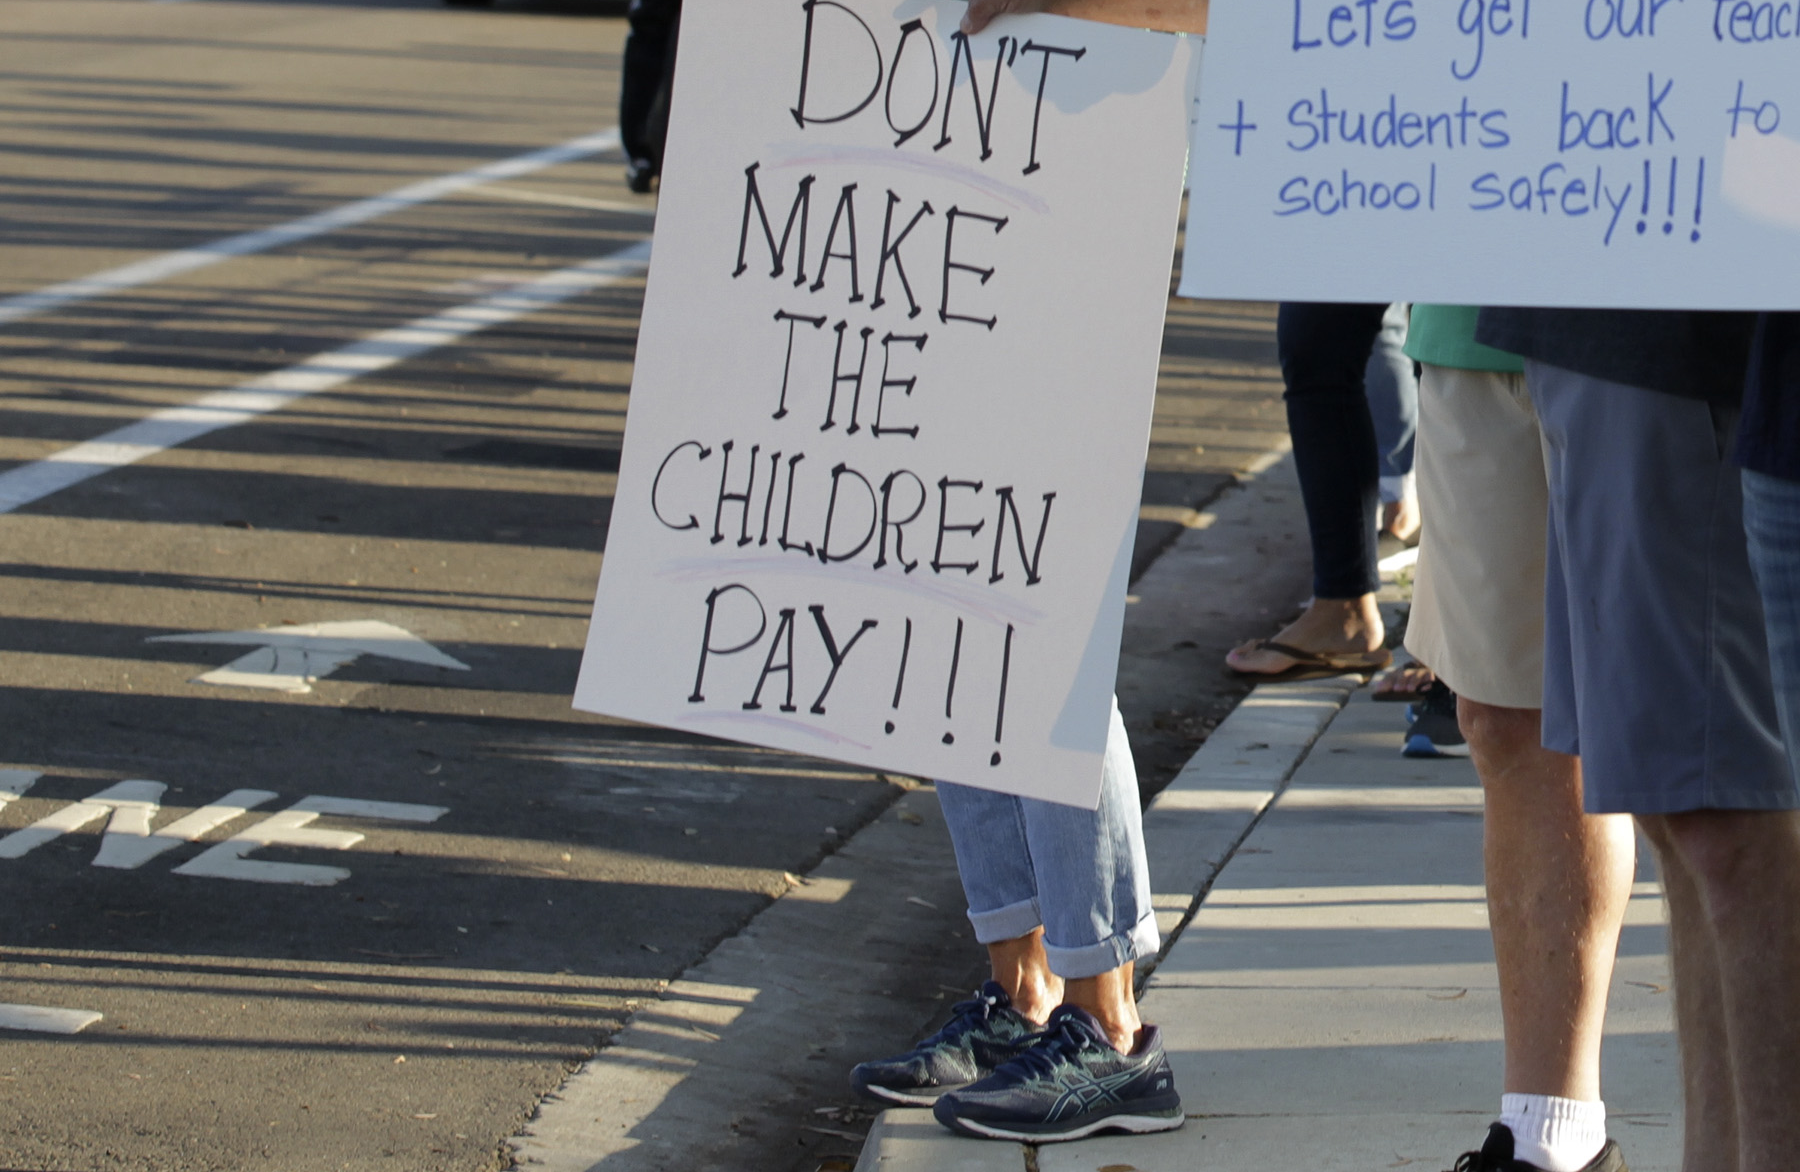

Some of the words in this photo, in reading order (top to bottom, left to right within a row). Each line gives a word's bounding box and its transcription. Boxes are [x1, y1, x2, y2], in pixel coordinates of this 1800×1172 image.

[1727, 78, 1782, 140] to
[731, 161, 1010, 331] MAKE
[1272, 162, 1436, 217] school
[1467, 155, 1707, 247] safely!!!
[772, 310, 930, 439] THE
[651, 439, 1059, 587] CHILDREN
[687, 581, 1015, 768] PAY!!!
[0, 769, 451, 886] NE
